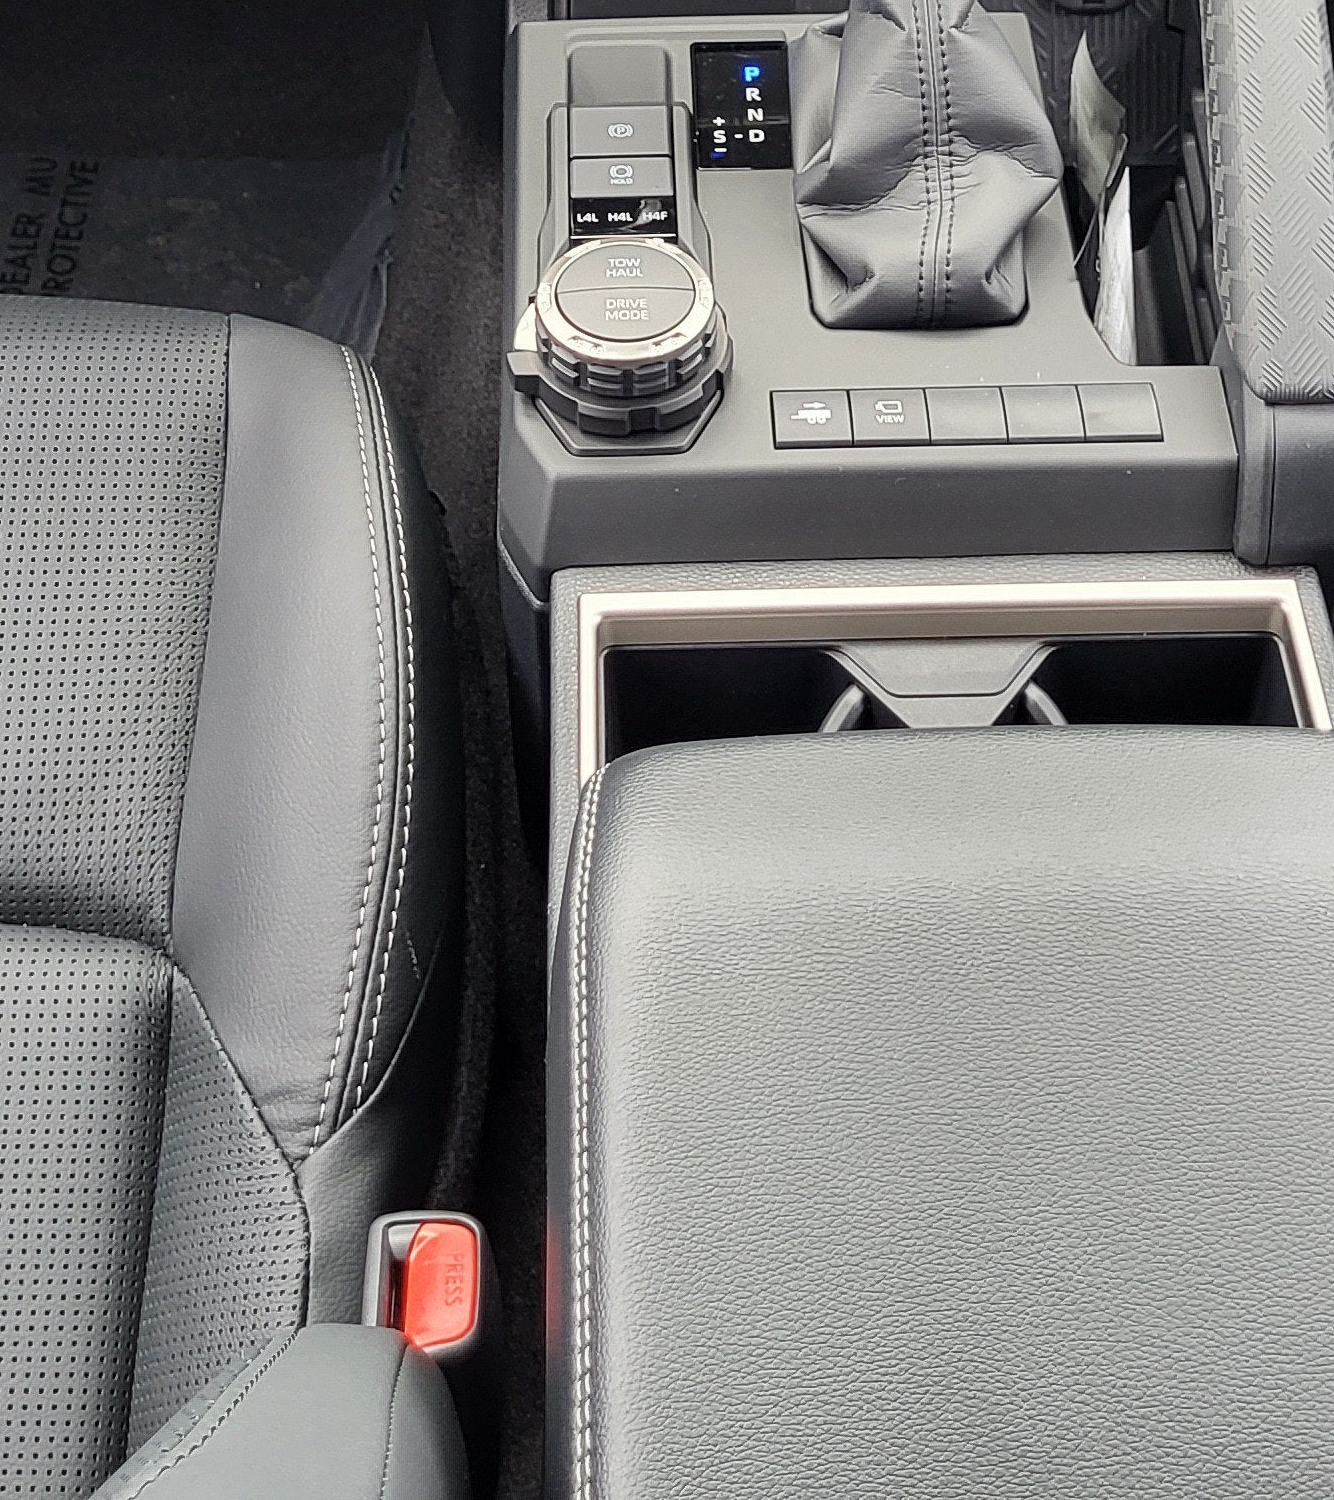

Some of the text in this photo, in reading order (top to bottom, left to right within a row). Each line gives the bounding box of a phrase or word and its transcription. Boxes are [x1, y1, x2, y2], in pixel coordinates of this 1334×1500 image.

[743, 66, 761, 82] P
[745, 87, 762, 102] R
[747, 108, 764, 122] N
[713, 130, 727, 144] S
[748, 129, 765, 143] D
[576, 211, 599, 223] L4L
[607, 211, 633, 222] H4L
[38, 159, 99, 297] ROTECTIVE
[607, 257, 641, 268] TOW
[605, 267, 644, 278] HAUL
[605, 298, 648, 309] DRIVE
[604, 310, 650, 321] MODE
[875, 414, 905, 424] VIEW
[444, 1251, 465, 1307] PRESS
